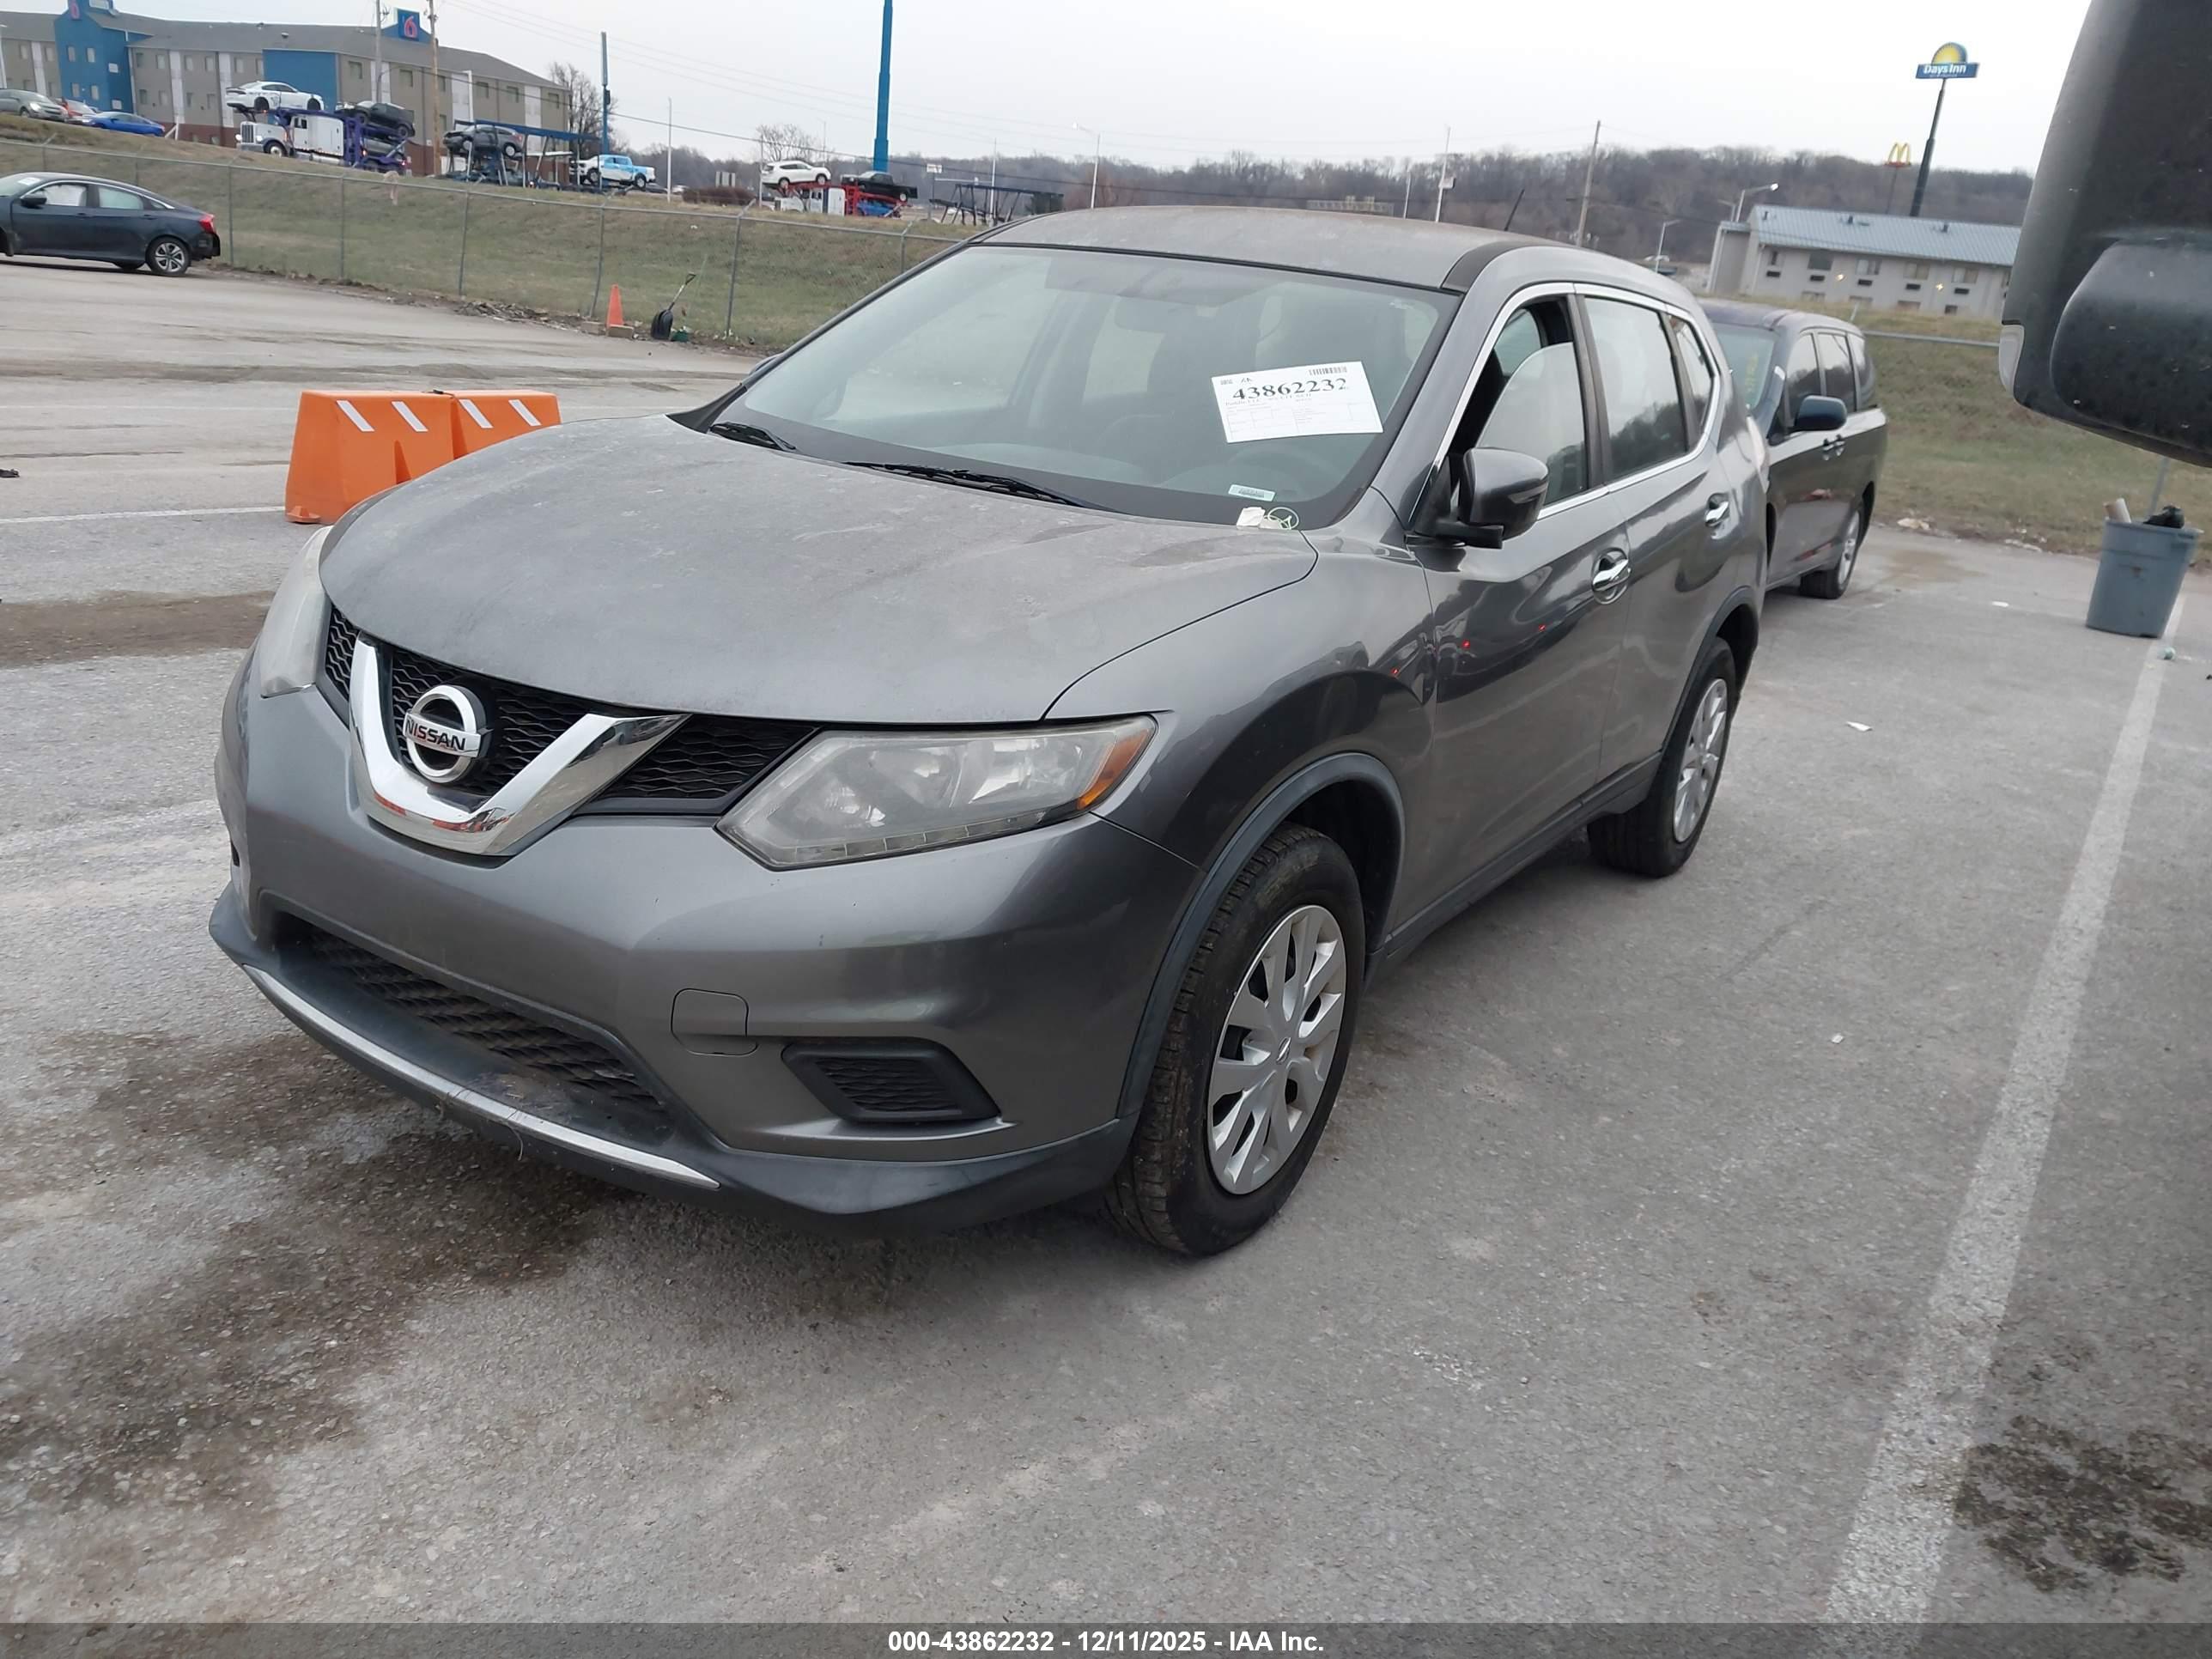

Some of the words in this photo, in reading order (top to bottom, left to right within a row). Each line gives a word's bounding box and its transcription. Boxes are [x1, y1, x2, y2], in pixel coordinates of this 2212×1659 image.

[404, 15, 418, 39] 6
[1923, 64, 1948, 75] Days
[1949, 64, 1966, 74] Inn
[1232, 378, 1346, 400] 43862232
[404, 717, 465, 751] NISSAN
